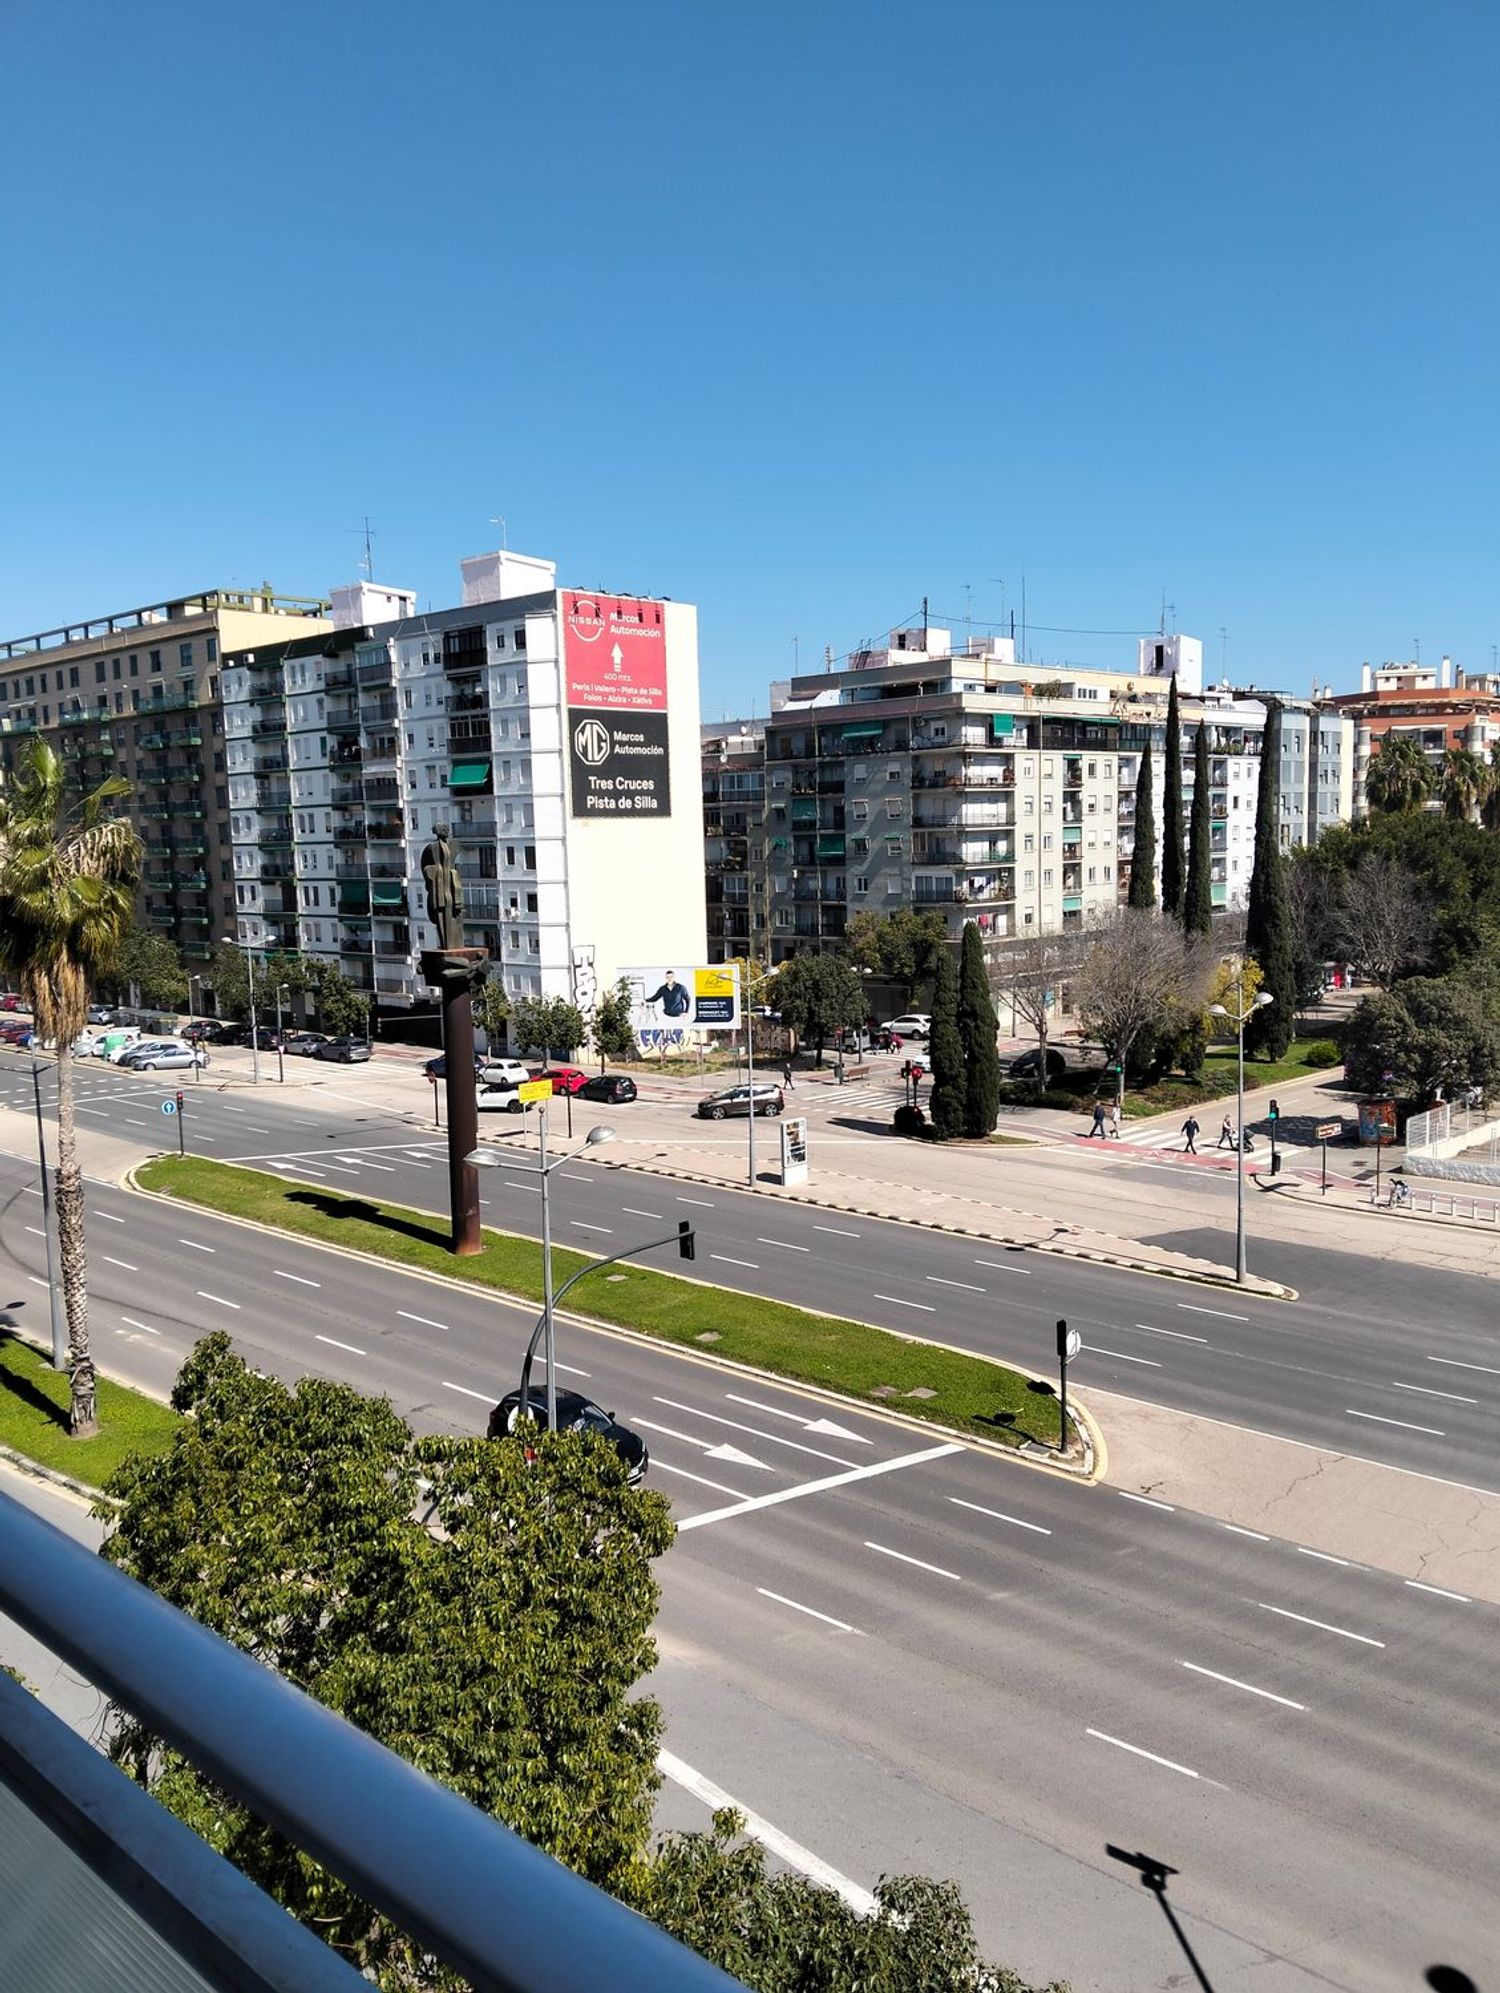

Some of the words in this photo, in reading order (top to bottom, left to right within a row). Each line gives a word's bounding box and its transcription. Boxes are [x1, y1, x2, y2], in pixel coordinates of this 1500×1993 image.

[568, 616, 606, 626] NISSAN
[610, 613, 639, 624] Mrcos
[610, 625, 661, 637] Automoción
[639, 687, 648, 695] de
[648, 687, 662, 696] Silla
[613, 731, 644, 741] Marcos
[577, 723, 608, 762] MG
[614, 744, 664, 755] Automoción
[588, 776, 614, 789] Tres
[615, 776, 655, 790] Cruces
[587, 796, 615, 808] Pista
[618, 796, 632, 809] de
[634, 796, 658, 809] Silla
